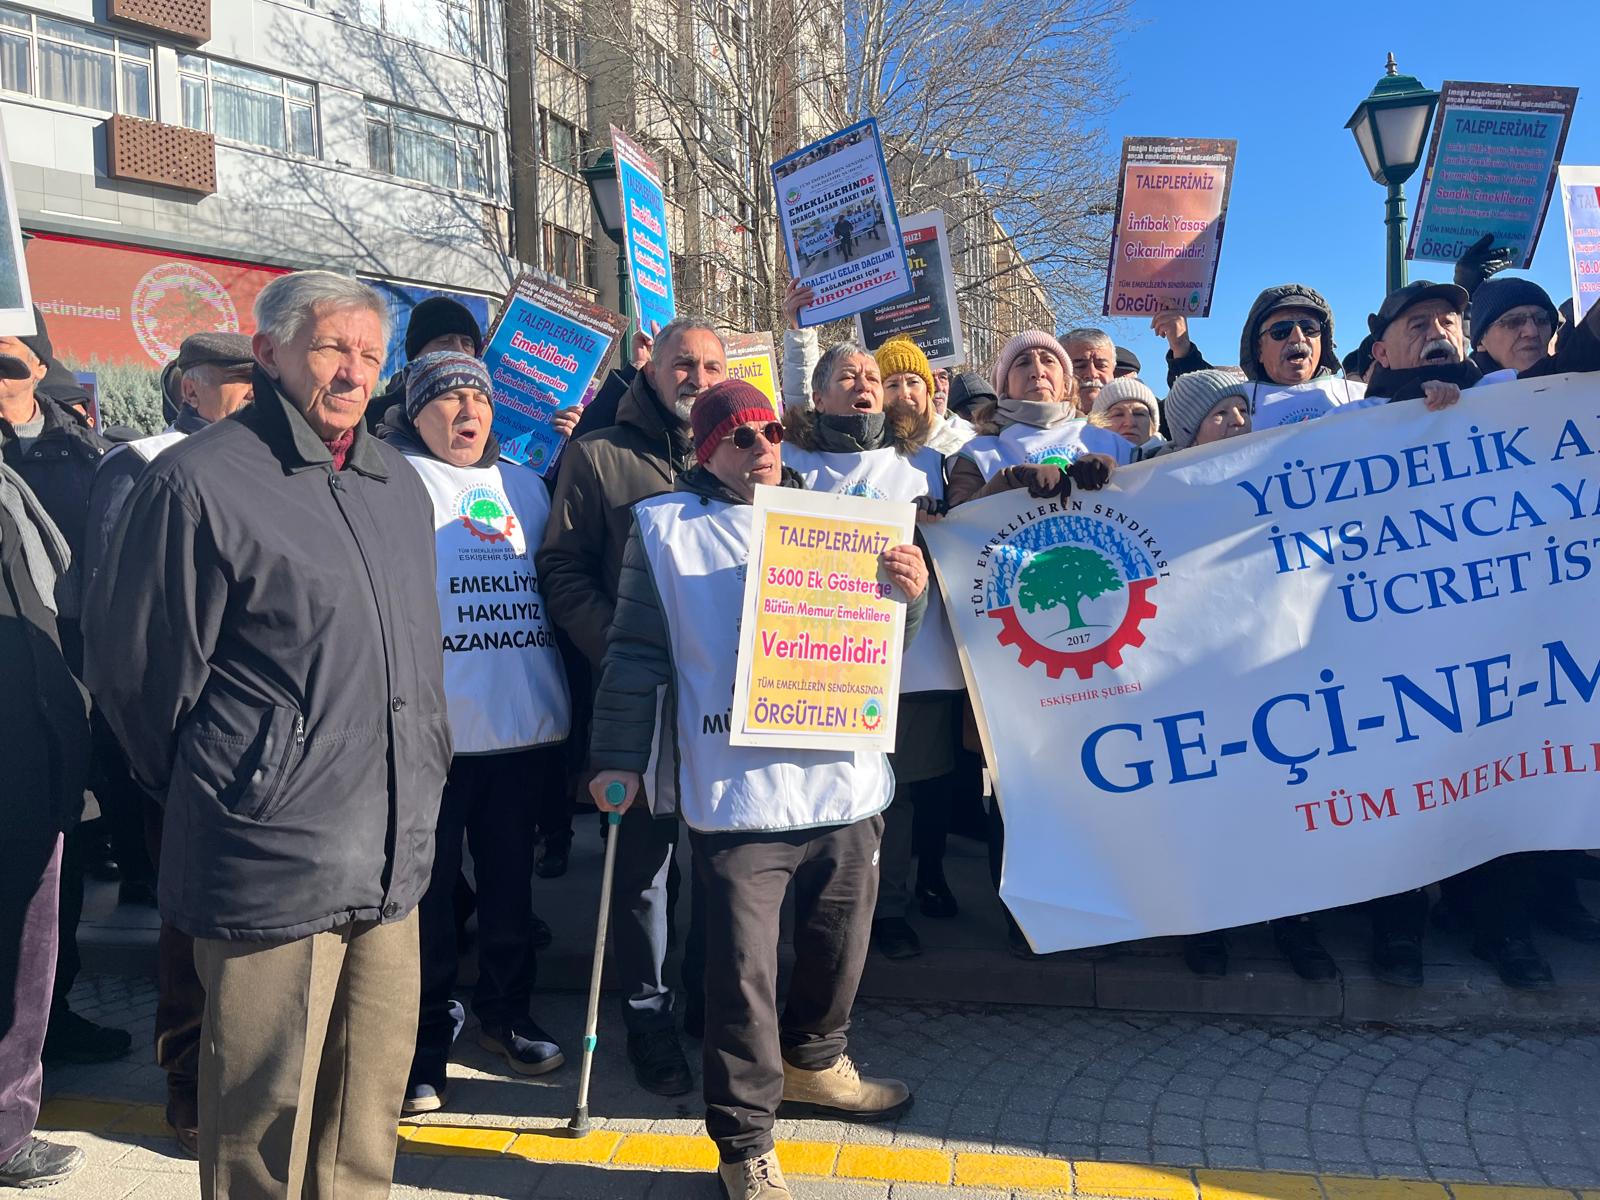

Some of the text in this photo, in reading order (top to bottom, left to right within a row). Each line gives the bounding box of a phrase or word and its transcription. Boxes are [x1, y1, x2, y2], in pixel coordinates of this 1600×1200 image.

[1456, 119, 1547, 139] TALEPLERİMİZ
[788, 174, 875, 217] EMEKLİLERİNDE
[1136, 172, 1214, 191] TALEPLERİMİZ
[817, 199, 839, 218] YAŞAM
[839, 190, 860, 208] HAKKI
[1128, 213, 1209, 232] İntibak Yasası
[904, 232, 921, 244] RUZ!
[838, 260, 860, 278] GELİR
[862, 249, 895, 270] DAĞILIMI
[864, 267, 880, 280] İÇİN
[807, 270, 897, 308] YÜRÜYORUZ!
[1119, 280, 1131, 289] TÜM
[518, 308, 597, 353] TALEPLERİMİZ
[917, 337, 950, 348] KLİLERİN
[511, 331, 578, 372] Emeklilerin
[501, 355, 567, 391] Sendikalaşmaları
[728, 362, 763, 380] ERİMİZ
[494, 369, 560, 406] Önündeki Engeller
[492, 387, 546, 421] aldırılmalıdır
[1237, 413, 1600, 517] YÜZDELİK A
[780, 526, 889, 555] TALEPLERİMİZ
[1268, 479, 1600, 574] İNSANCA Y
[459, 553, 502, 562] ESKİŞEHİR
[971, 501, 1170, 617] TÜM EMEKLİLERİN SENDİKASI
[450, 571, 538, 594] EMEKLİYİZ
[768, 567, 892, 600] 3600 Ek Gösterge
[1337, 551, 1532, 623] ÜCRET
[458, 603, 541, 623] HAKLIYIZ
[764, 598, 891, 623] Bütün Memur Emeklilere
[443, 625, 555, 652] AZANACAĞIZ
[761, 631, 888, 665] Verilmelidir!
[1067, 633, 1091, 646] 2017
[758, 676, 884, 695] TÜM EMEKLİLERİN SENDİKASINDA
[1041, 680, 1142, 707] ESKİŞEHİR ŞUBESİ
[755, 697, 857, 728] ÖRGÜTLEN !
[1295, 788, 1400, 832] TÜM
